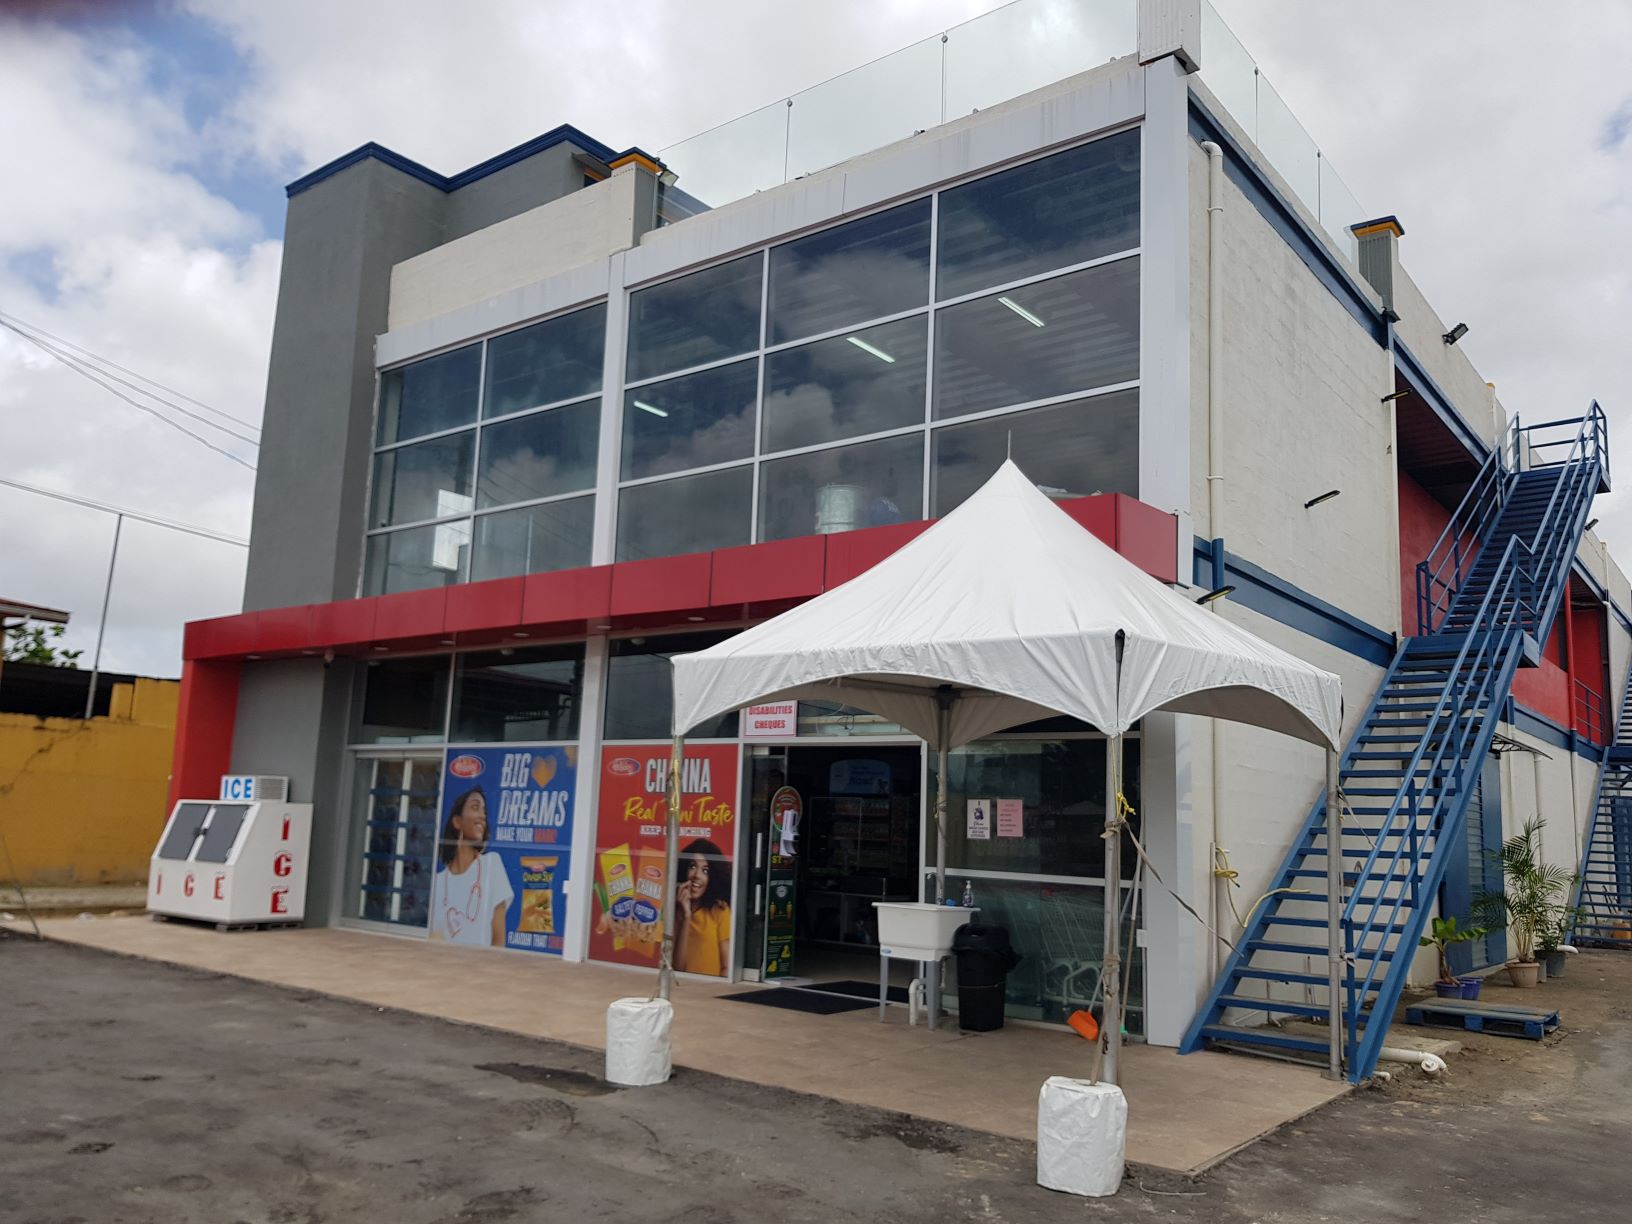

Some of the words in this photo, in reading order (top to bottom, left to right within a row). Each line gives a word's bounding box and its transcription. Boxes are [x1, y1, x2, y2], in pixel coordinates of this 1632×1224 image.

[749, 705, 792, 715] DISABILITIES
[755, 719, 785, 729] CHEQUES
[500, 753, 533, 789] BIG
[645, 758, 711, 794] CHNNA
[224, 778, 253, 799] ICE
[497, 791, 569, 828] DREAMS
[623, 796, 657, 822] Real
[693, 796, 734, 826] Taste
[156, 873, 225, 900] ICE
